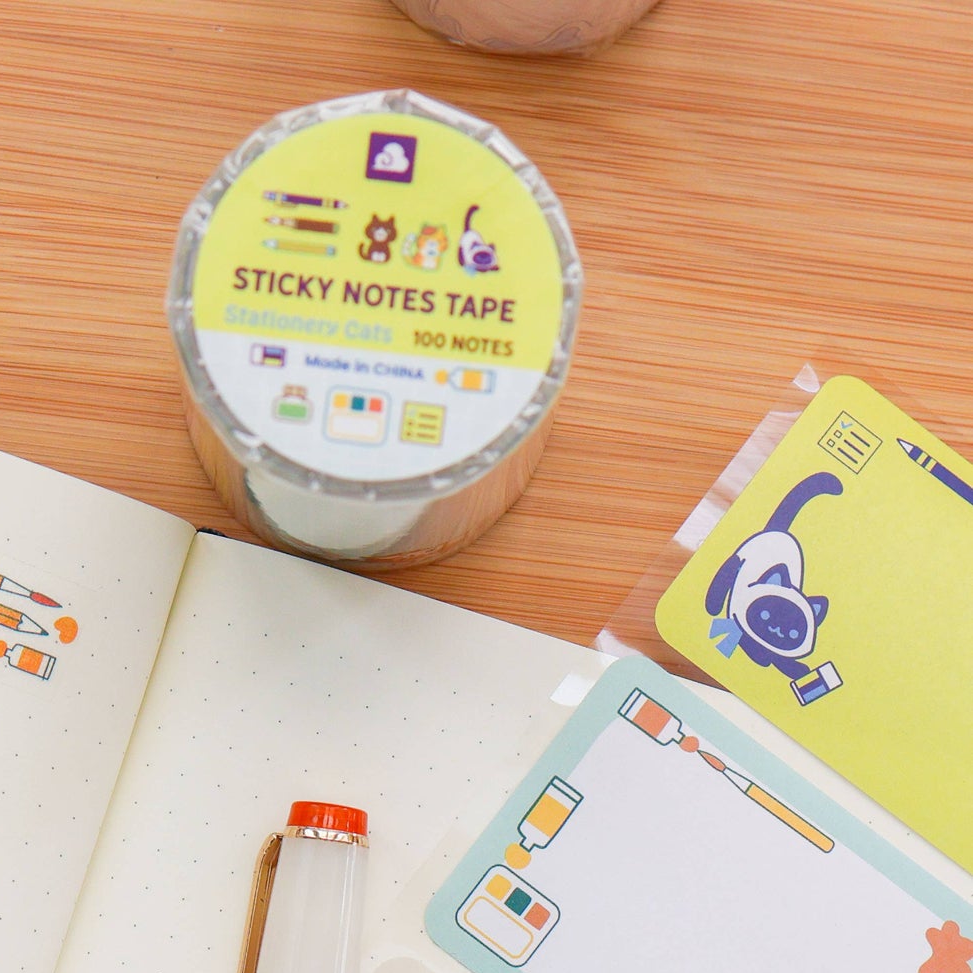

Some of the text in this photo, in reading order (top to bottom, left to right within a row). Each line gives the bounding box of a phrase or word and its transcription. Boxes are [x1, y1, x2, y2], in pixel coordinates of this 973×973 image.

[233, 266, 515, 322] STICKY NOTES TAPE
[225, 304, 393, 344] Stationery Cats
[413, 330, 514, 356] 100 NOTES
[305, 355, 424, 380] Made in CHINA
